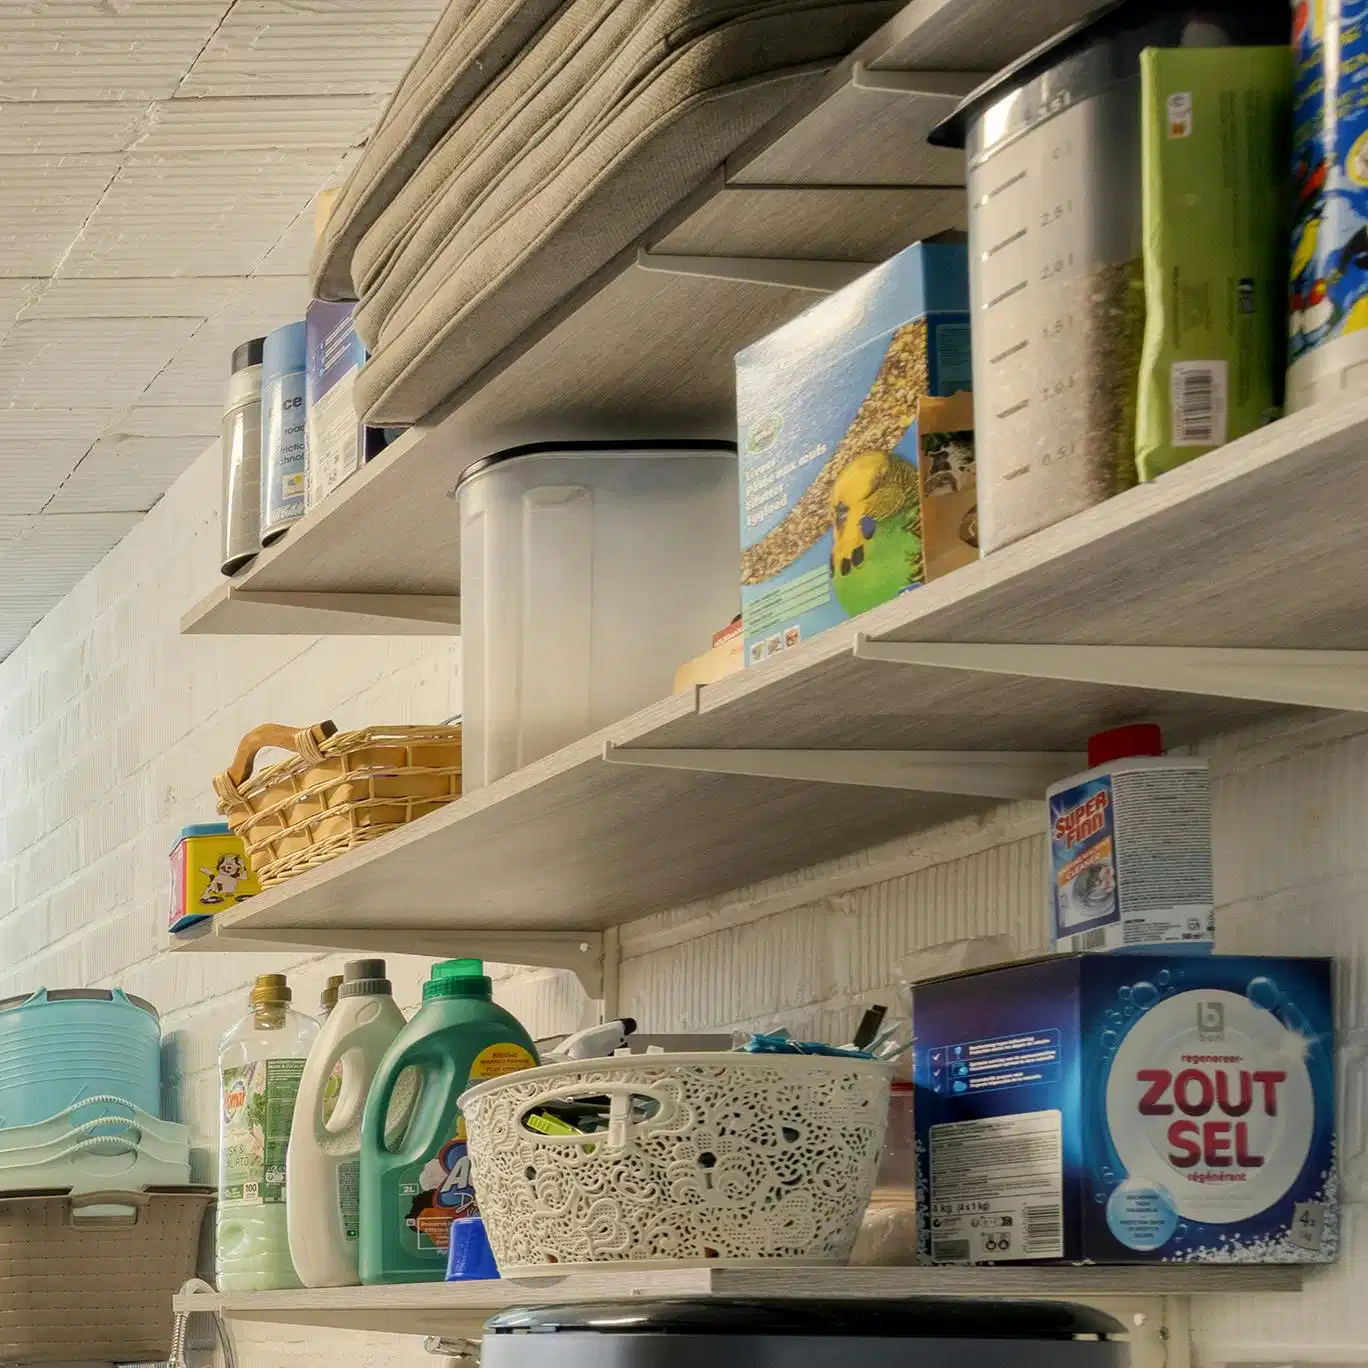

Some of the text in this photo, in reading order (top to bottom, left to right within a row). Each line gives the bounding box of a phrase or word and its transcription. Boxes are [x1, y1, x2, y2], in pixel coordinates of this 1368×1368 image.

[1055, 790, 1109, 840] SUPER
[1066, 809, 1106, 850] FINN
[1136, 1069, 1288, 1118] ZOUT
[1167, 1119, 1265, 1169] SEL
[245, 1183, 257, 1193] 100
